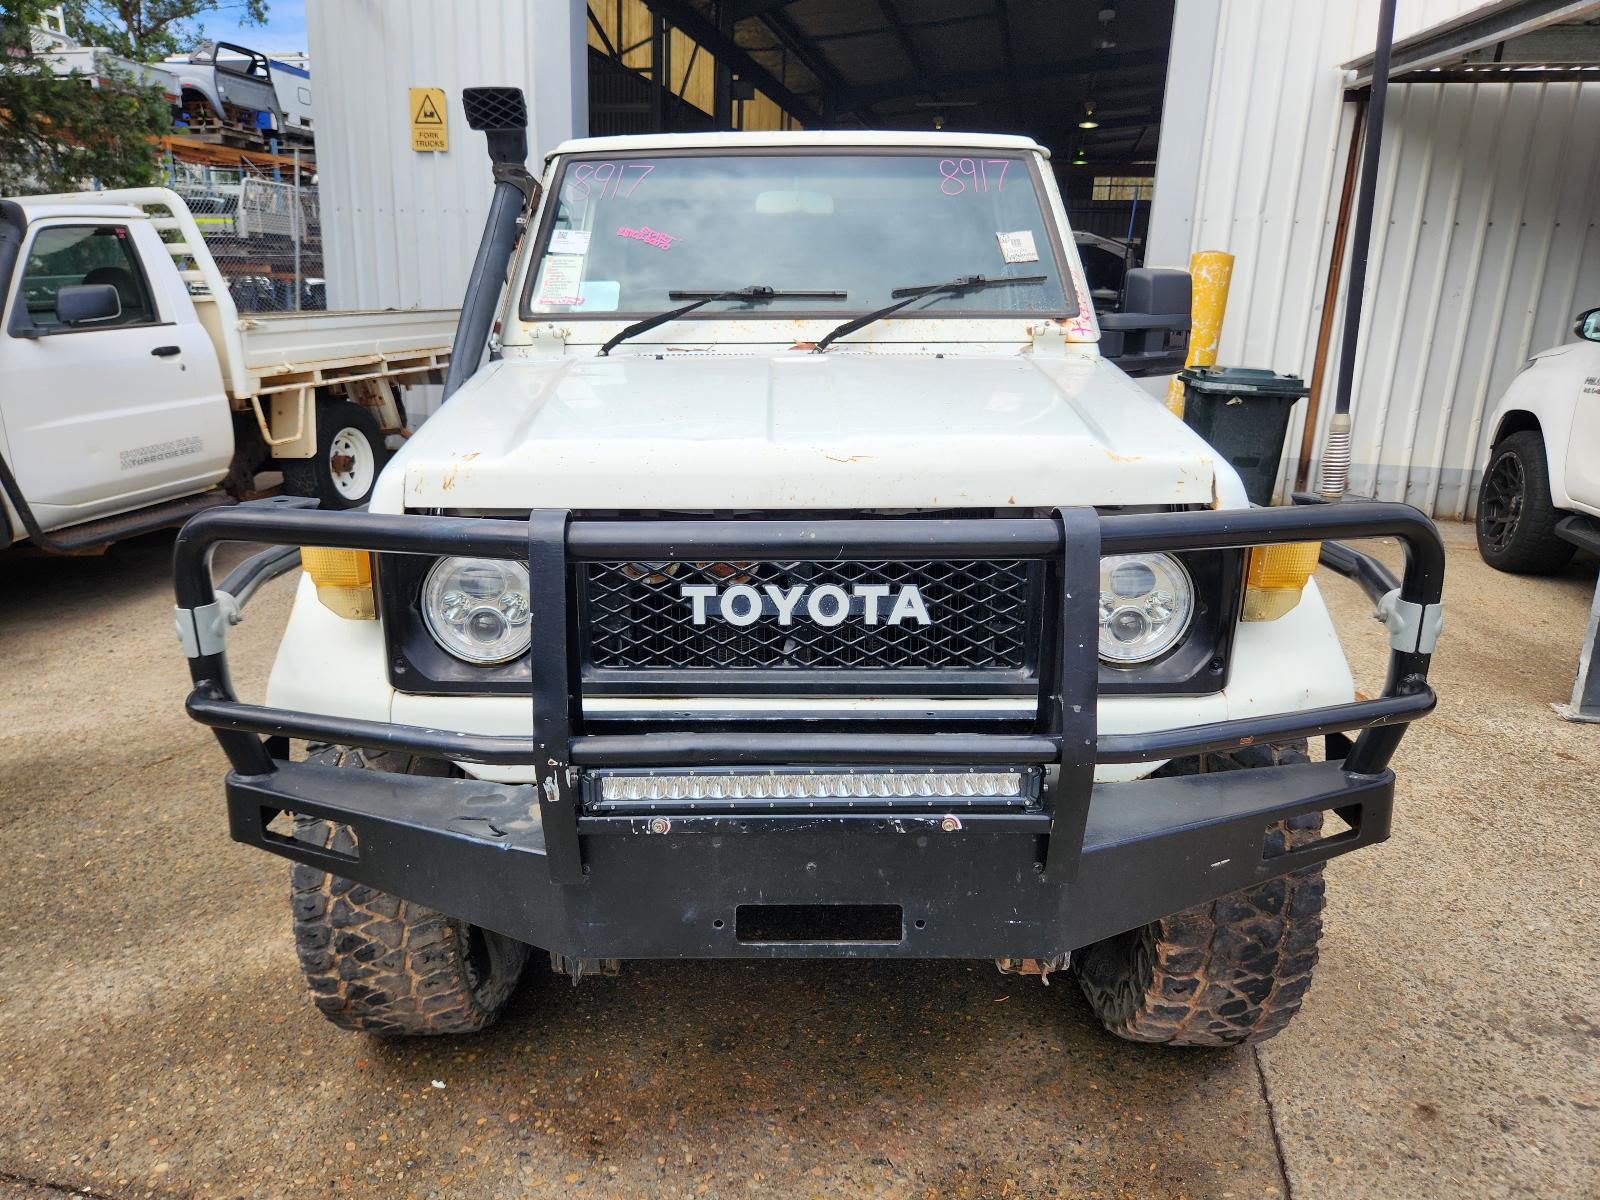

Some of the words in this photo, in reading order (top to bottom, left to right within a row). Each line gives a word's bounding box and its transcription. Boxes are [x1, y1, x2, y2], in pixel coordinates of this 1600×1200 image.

[574, 163, 655, 200] 8917
[940, 158, 1009, 195] 8917
[680, 583, 932, 627] TOYOTA
